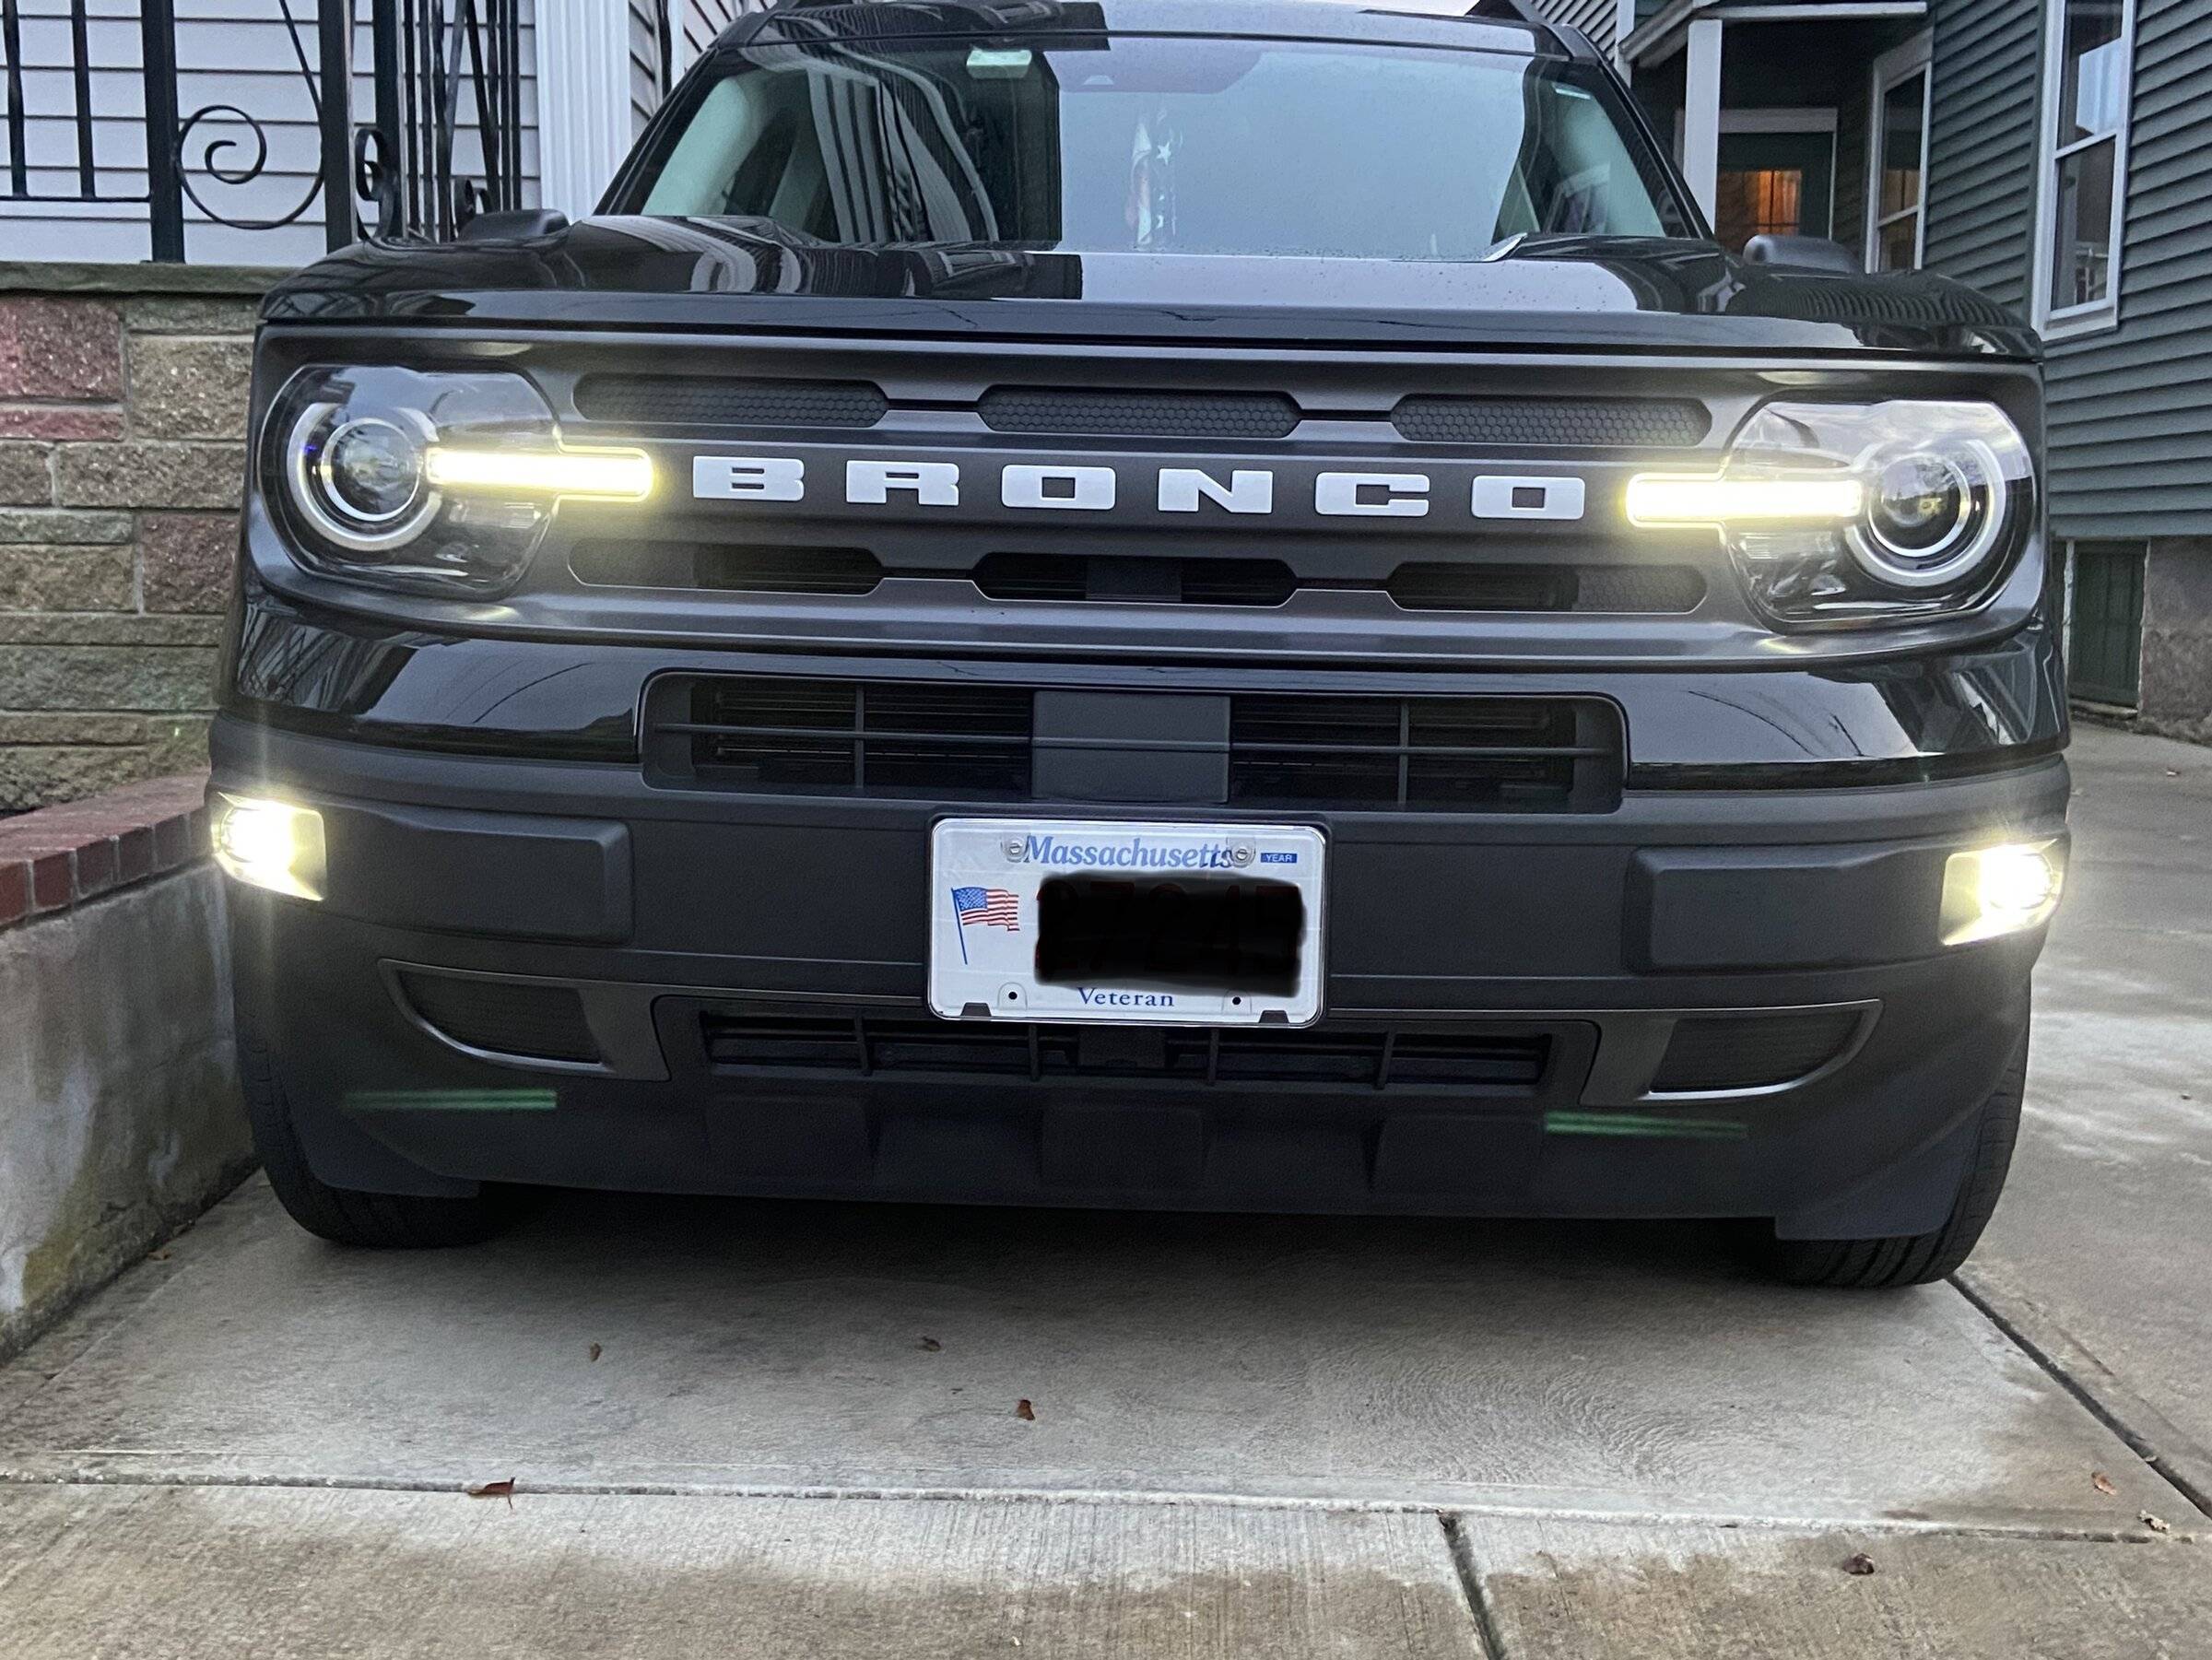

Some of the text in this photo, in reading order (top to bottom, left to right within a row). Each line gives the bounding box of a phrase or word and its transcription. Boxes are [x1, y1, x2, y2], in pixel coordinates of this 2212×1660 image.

[692, 455, 1585, 520] BRONCO
[1023, 833, 1233, 869] Massachusetts
[1265, 854, 1293, 863] YEAR
[1077, 986, 1174, 1007] Veteran
